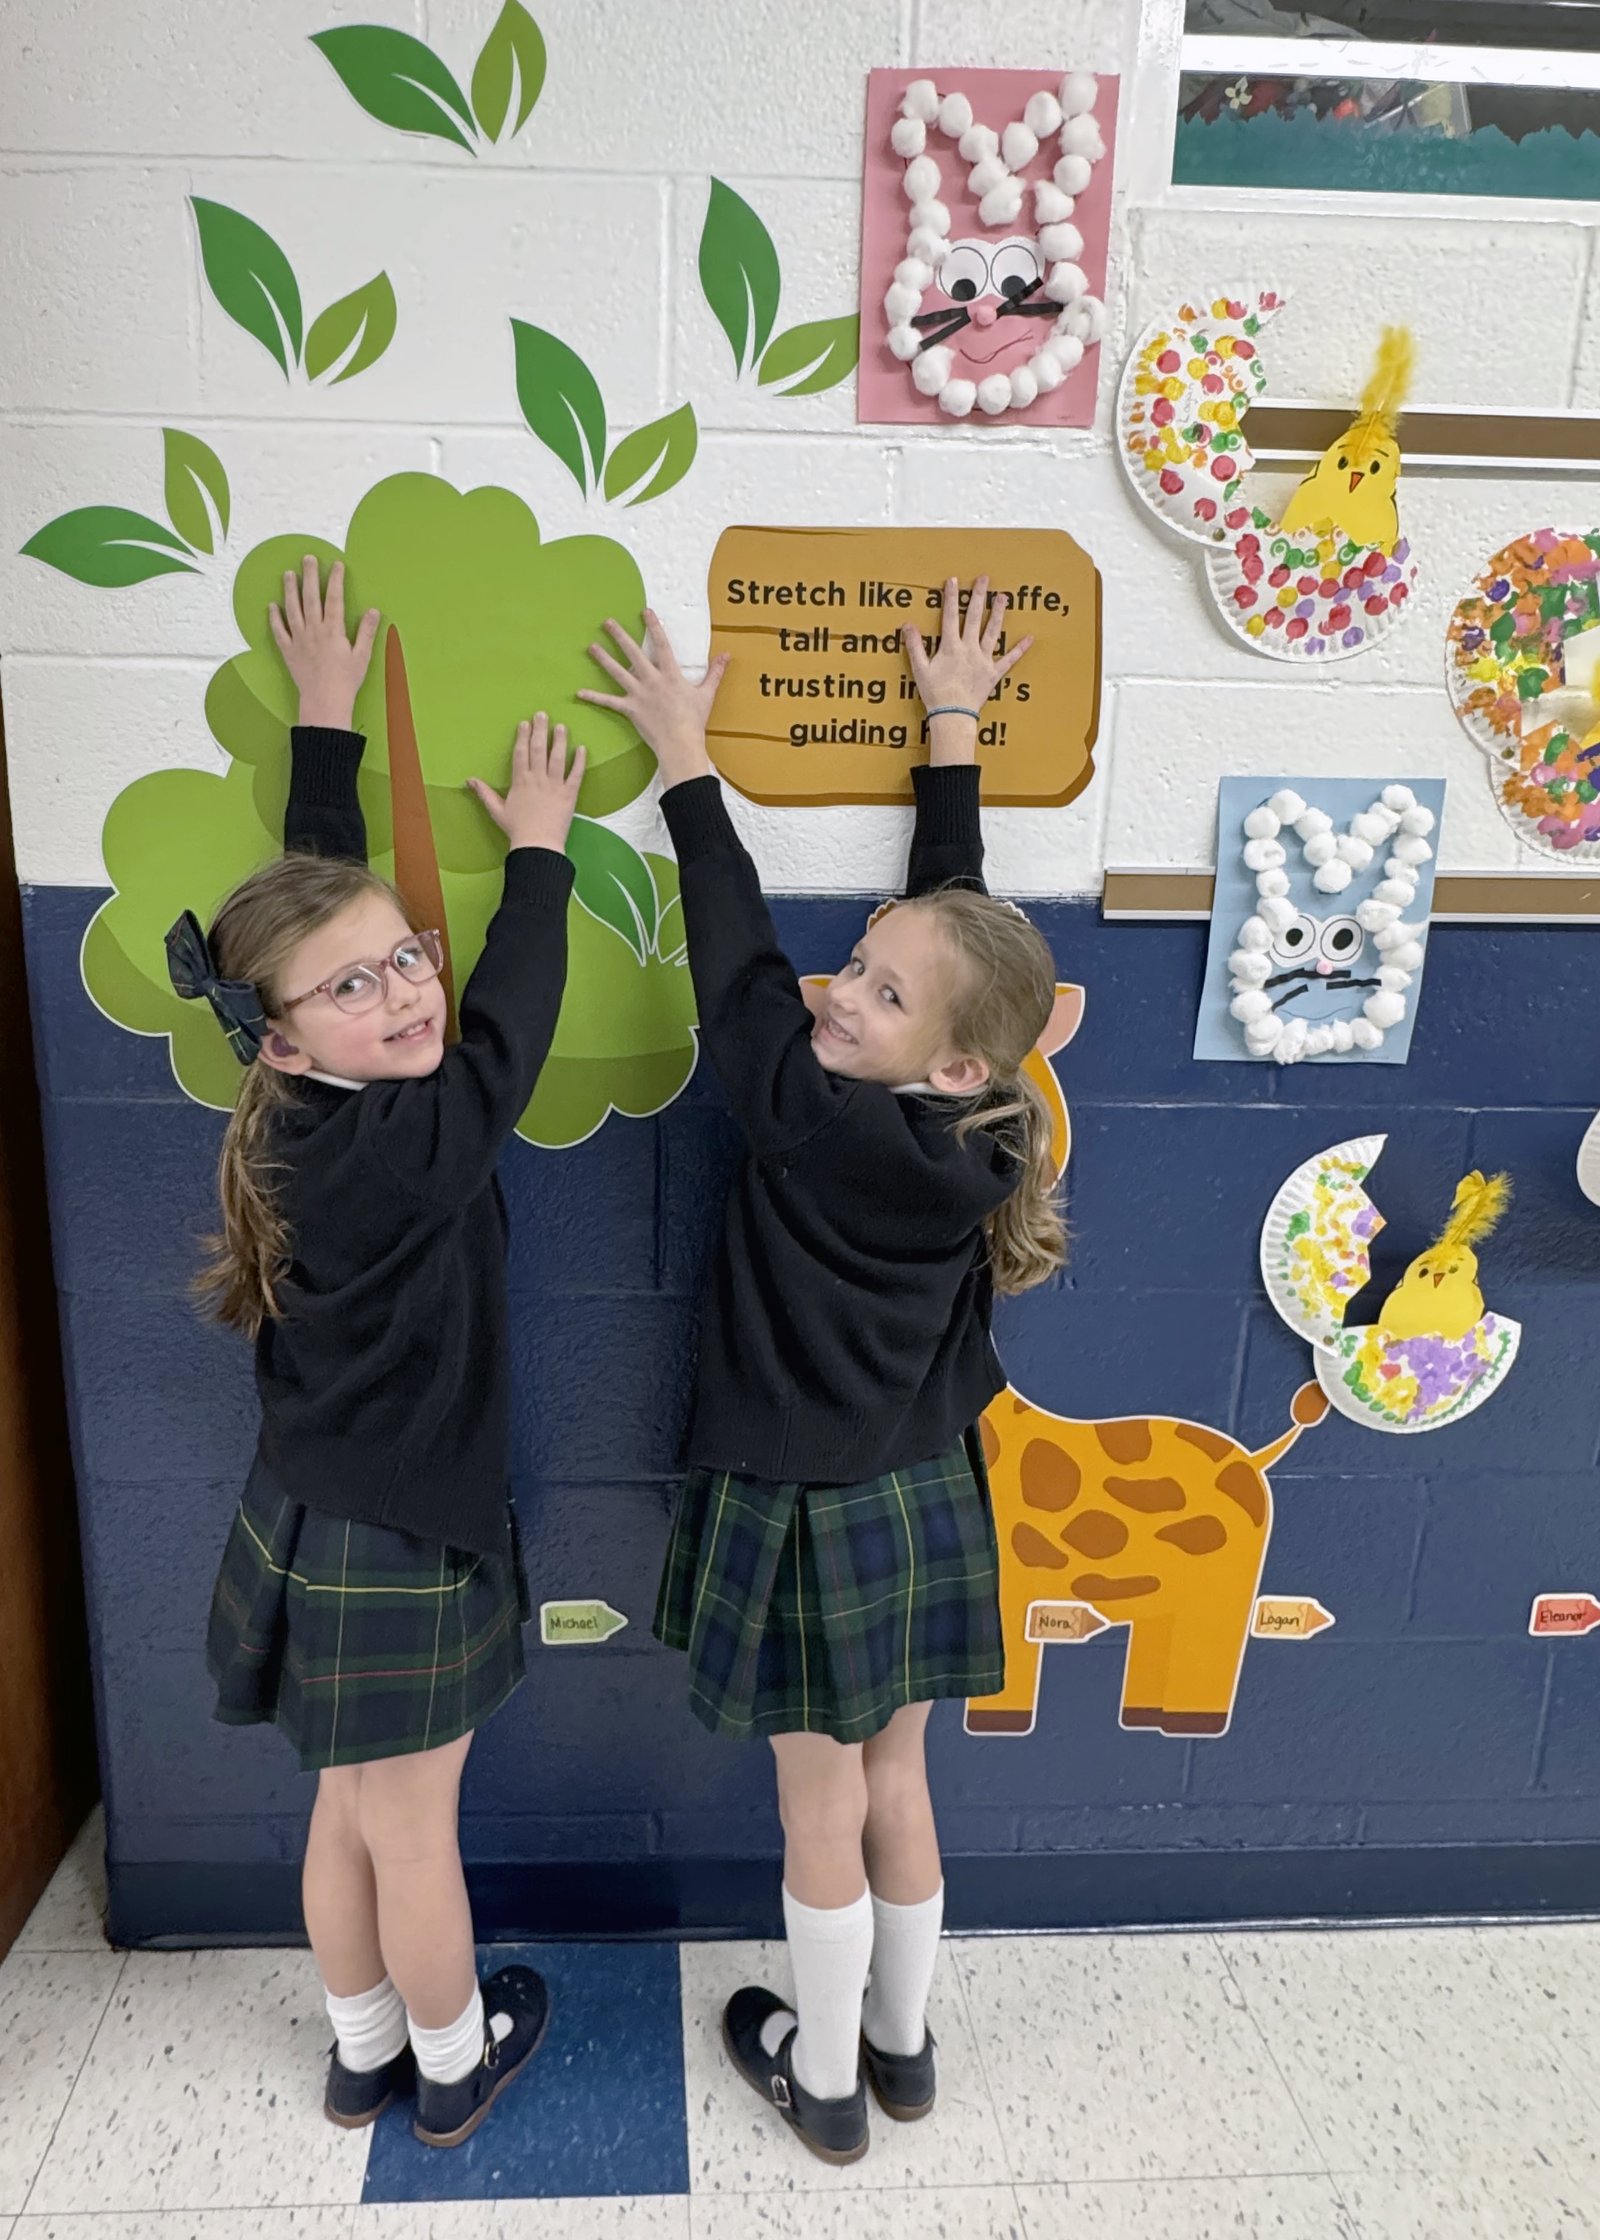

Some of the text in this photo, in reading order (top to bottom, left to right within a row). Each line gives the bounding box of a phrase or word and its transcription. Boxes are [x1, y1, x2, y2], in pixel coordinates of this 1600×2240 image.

[727, 579, 1070, 617] Stretch like a graffe,
[778, 627, 829, 652] tall
[841, 628, 902, 654] and
[759, 673, 886, 704] trusting
[789, 718, 908, 749] guiding
[549, 1615, 600, 1629] Michael
[1039, 1616, 1071, 1629] Nora
[1260, 1611, 1300, 1631] Logan
